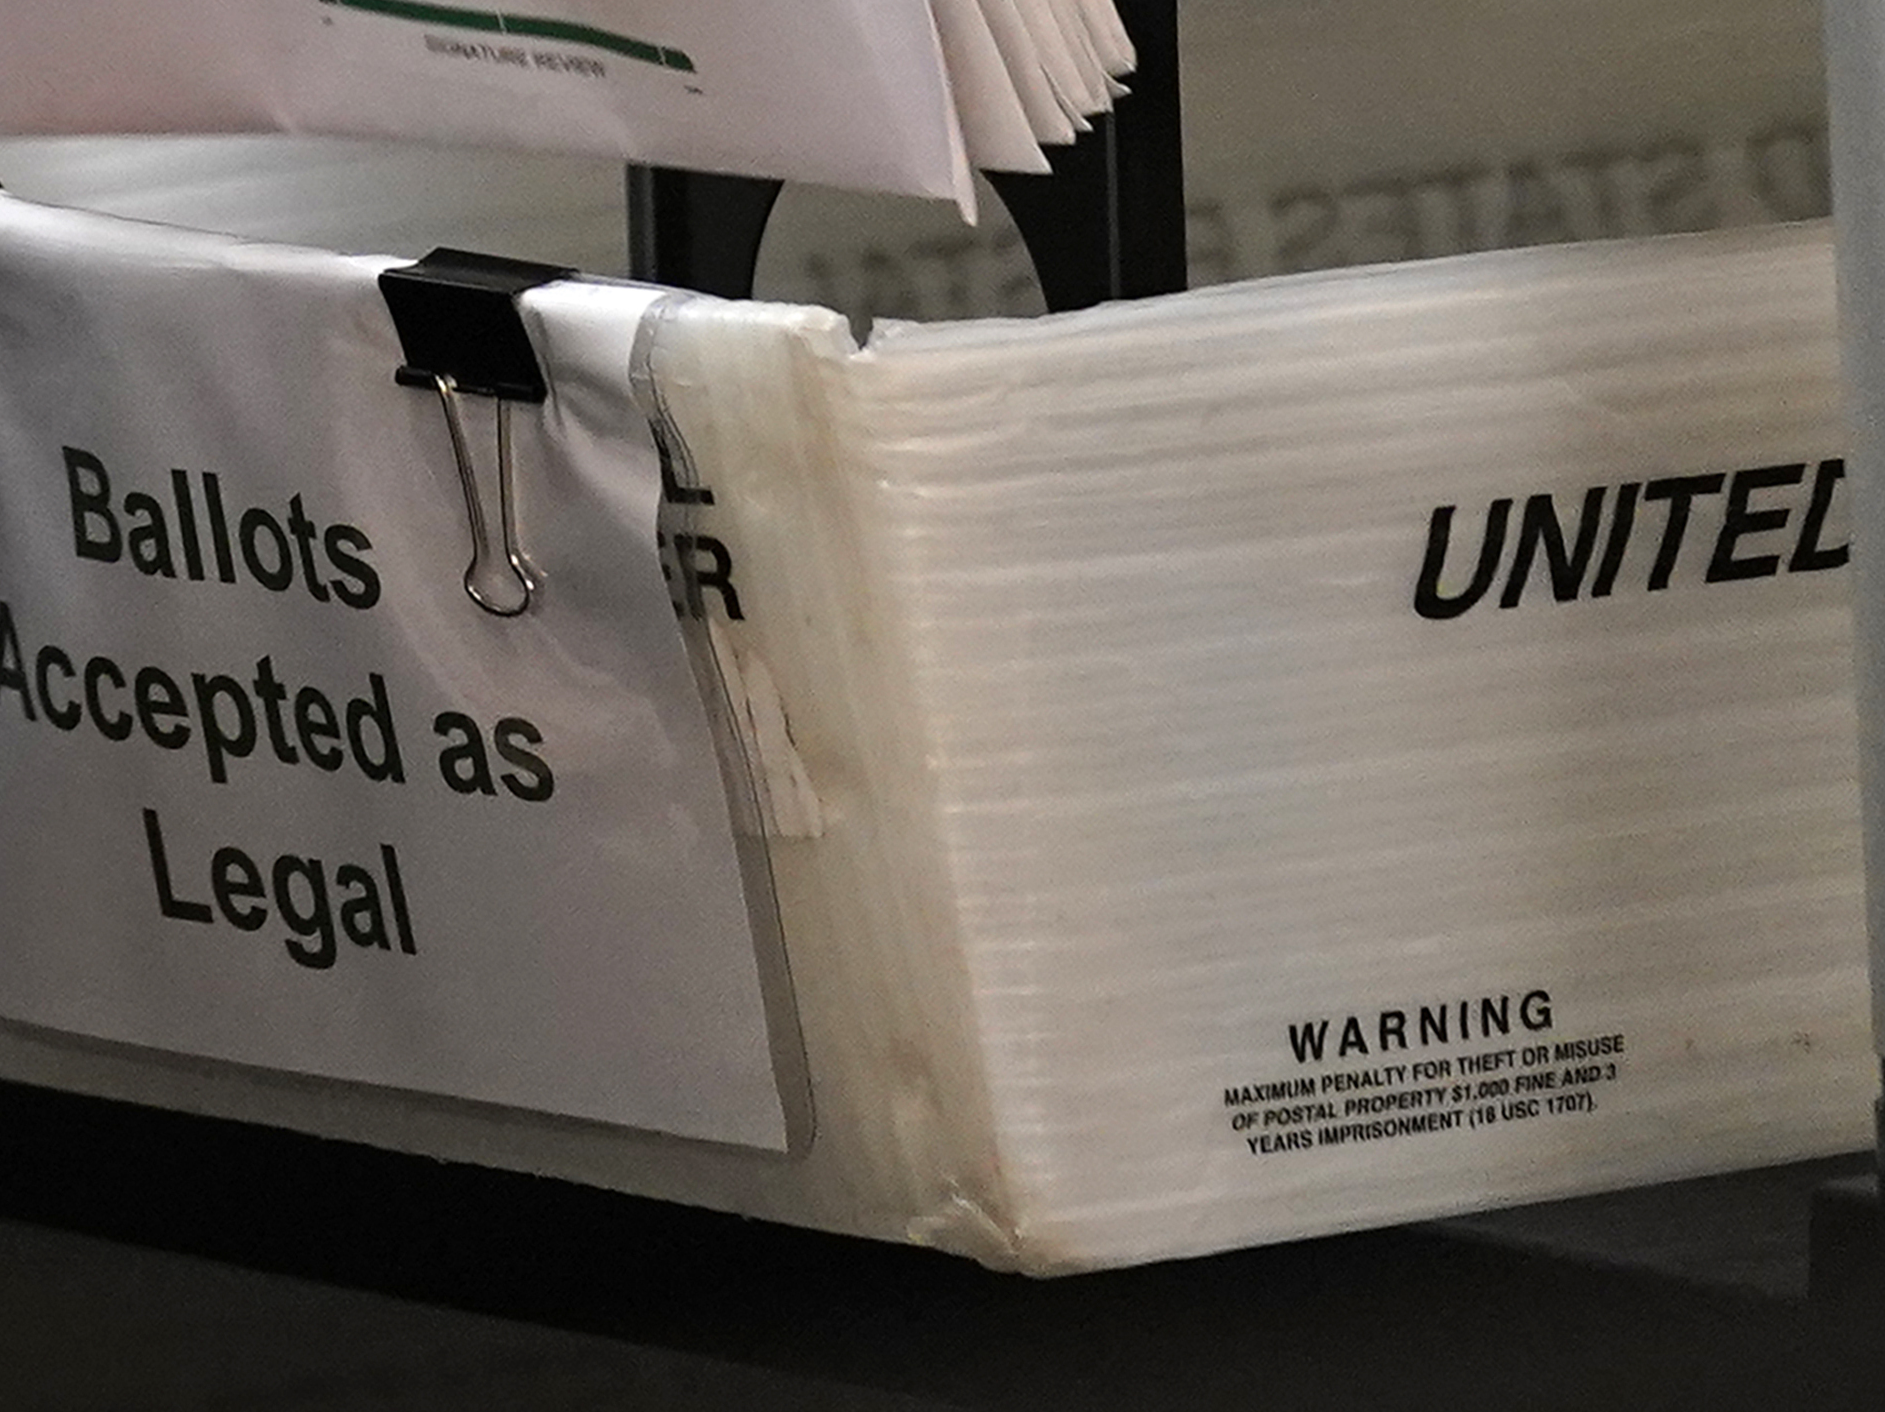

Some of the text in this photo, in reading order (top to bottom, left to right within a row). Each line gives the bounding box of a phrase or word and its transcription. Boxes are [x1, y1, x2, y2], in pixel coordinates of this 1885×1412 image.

[62, 445, 382, 610] Ballots
[433, 709, 556, 803] as
[142, 807, 418, 970] Legal
[1288, 989, 1554, 1065] WARNING
[1224, 1034, 1625, 1108] MAXIMUM PENALTY FOR THEFT OR MISUSE
[1231, 1110, 1260, 1132] OF
[1264, 1101, 1337, 1129] POSTAL
[1344, 1087, 1447, 1118] PROPERTY
[1516, 1072, 1556, 1095] FINE
[1561, 1065, 1602, 1087] AND
[1606, 1061, 1617, 1081] 3
[1246, 1129, 1314, 1155] YEARS
[1318, 1110, 1463, 1147] IMPRISONMENT
[1469, 1105, 1496, 1130] (18
[1501, 1099, 1540, 1122] USC
